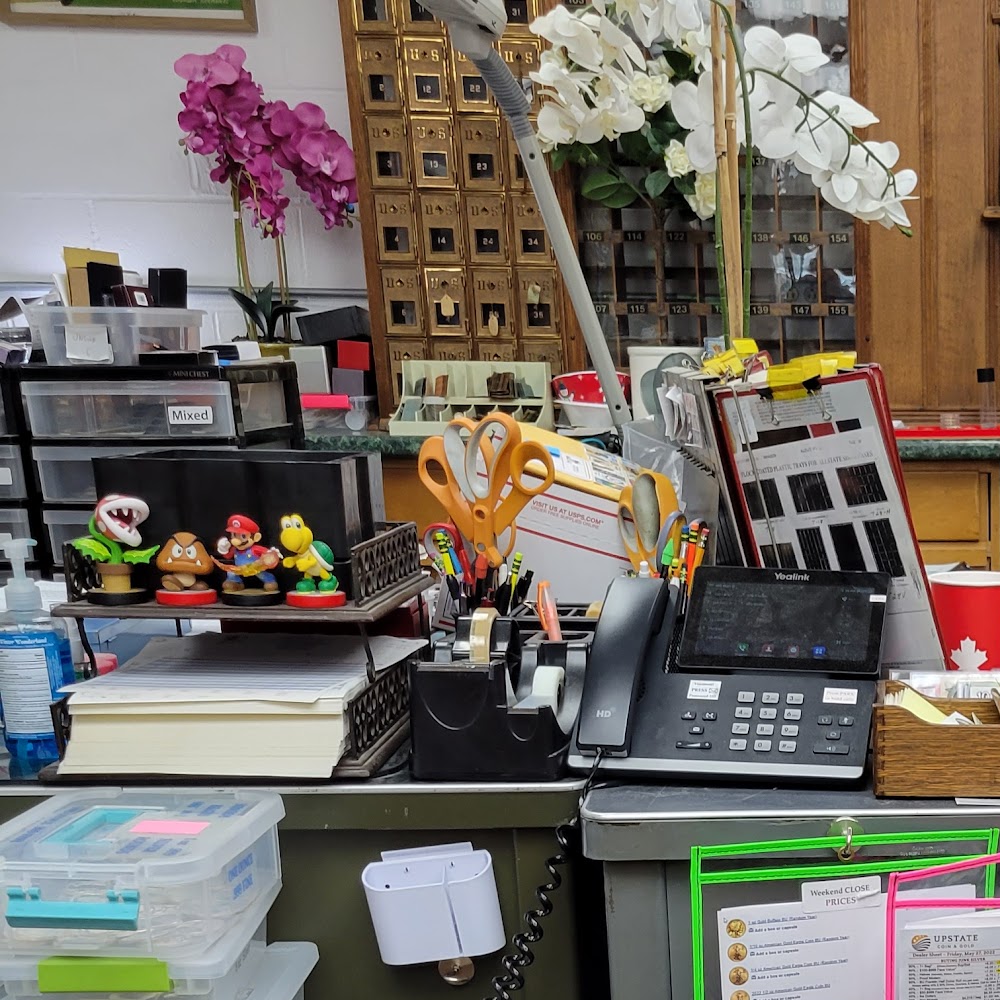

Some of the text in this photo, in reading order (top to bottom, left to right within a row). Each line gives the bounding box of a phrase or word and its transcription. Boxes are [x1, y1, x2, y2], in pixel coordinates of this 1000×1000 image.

[512, 8, 521, 16] 31
[793, 234, 808, 242] 146
[831, 234, 846, 242] 154
[752, 306, 768, 314] 139
[794, 306, 810, 315] 147
[830, 306, 846, 315] 155
[172, 410, 208, 420] Mixed
[532, 500, 548, 508] VISIT
[774, 572, 810, 581] Yealink
[596, 710, 612, 718] HD
[810, 884, 870, 897] Weekend CLOSE
[826, 897, 856, 906] PRICES
